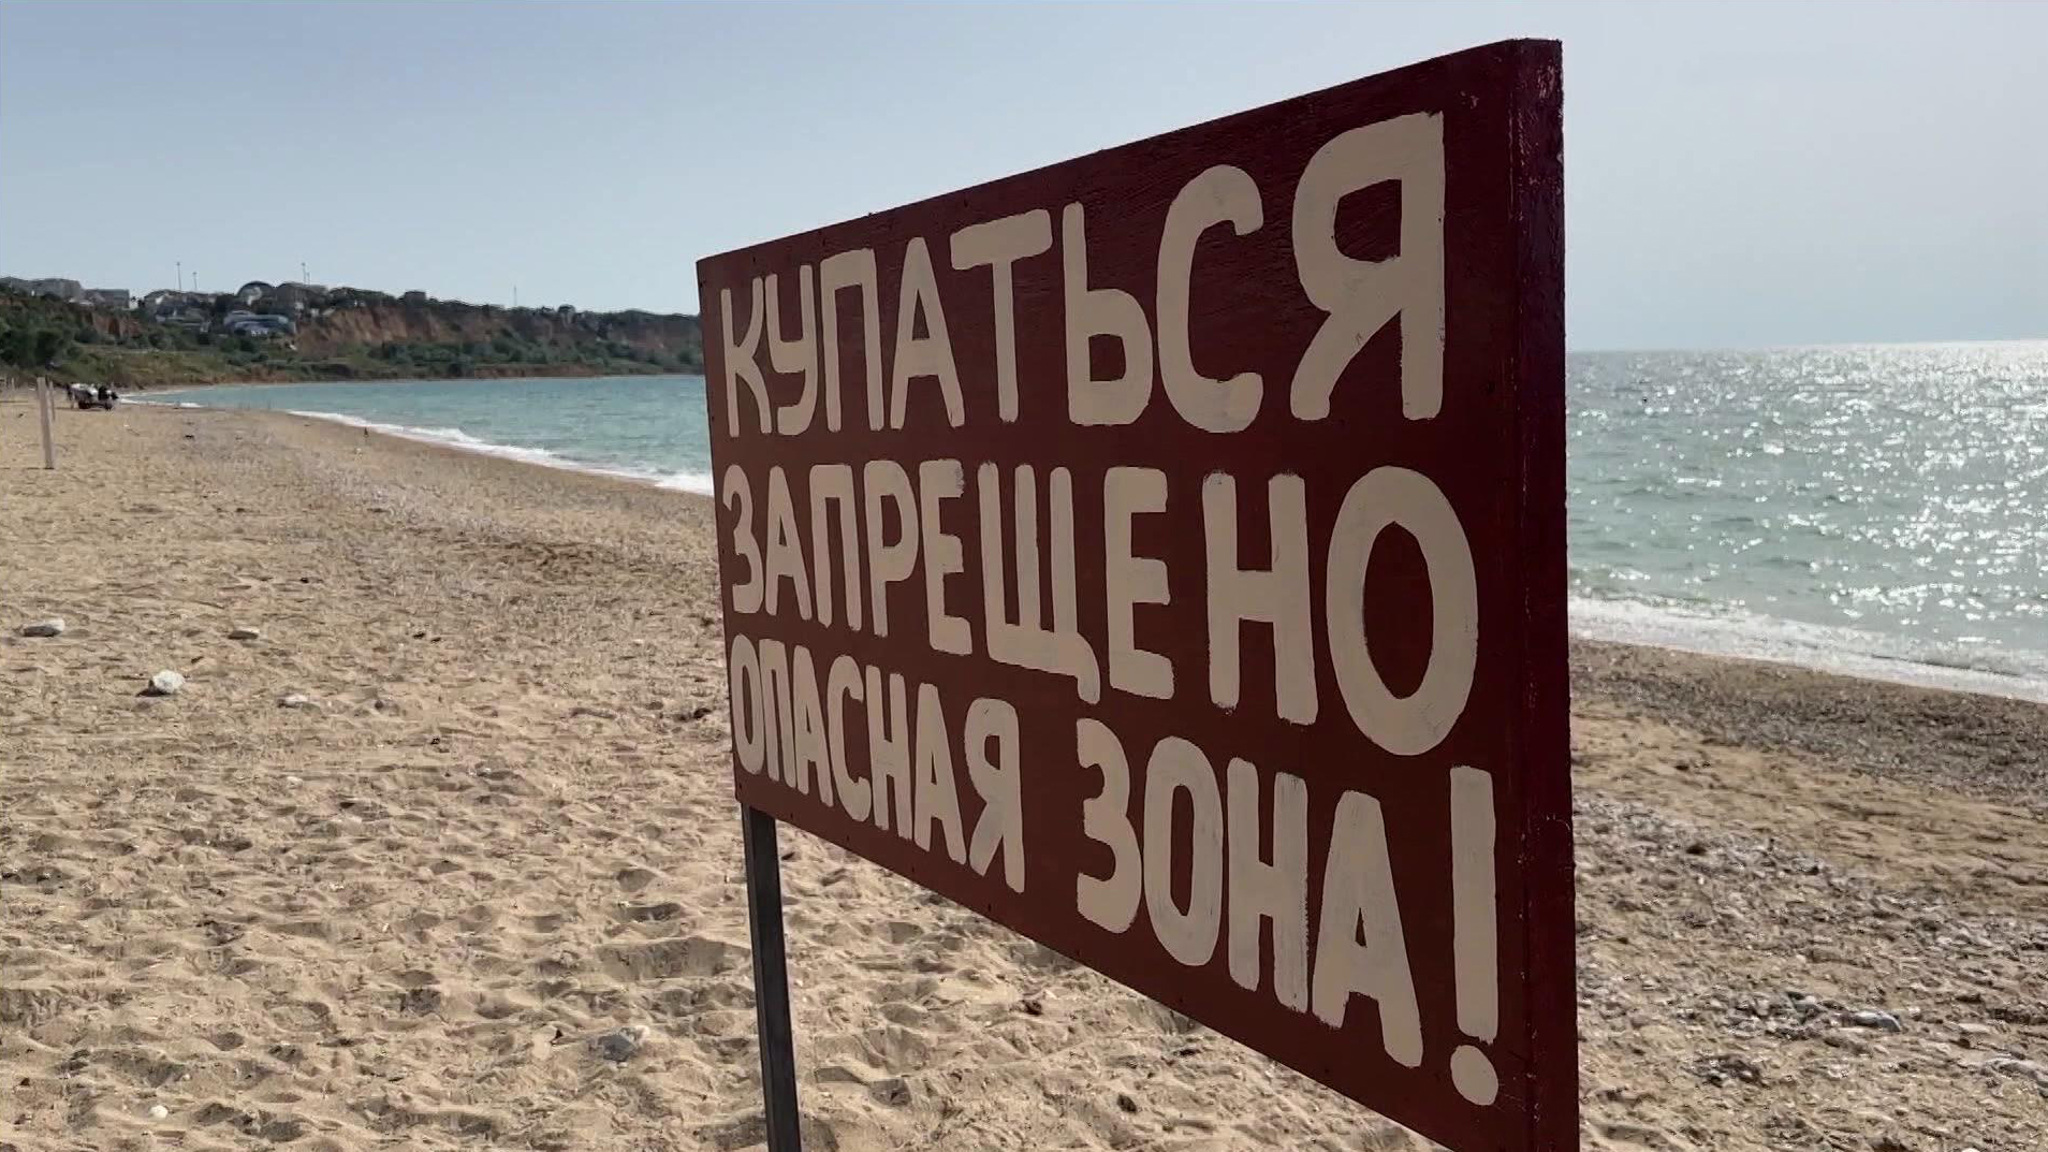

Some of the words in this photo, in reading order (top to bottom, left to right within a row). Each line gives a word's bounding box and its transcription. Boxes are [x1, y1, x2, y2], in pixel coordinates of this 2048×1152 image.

[721, 110, 1445, 438] КУПАТЬСЯ
[722, 459, 1478, 756] ЗАПРЕЩЕНО
[730, 634, 1025, 893] ОПАСНАЯ
[1076, 717, 1498, 1106] ЗОНА!
